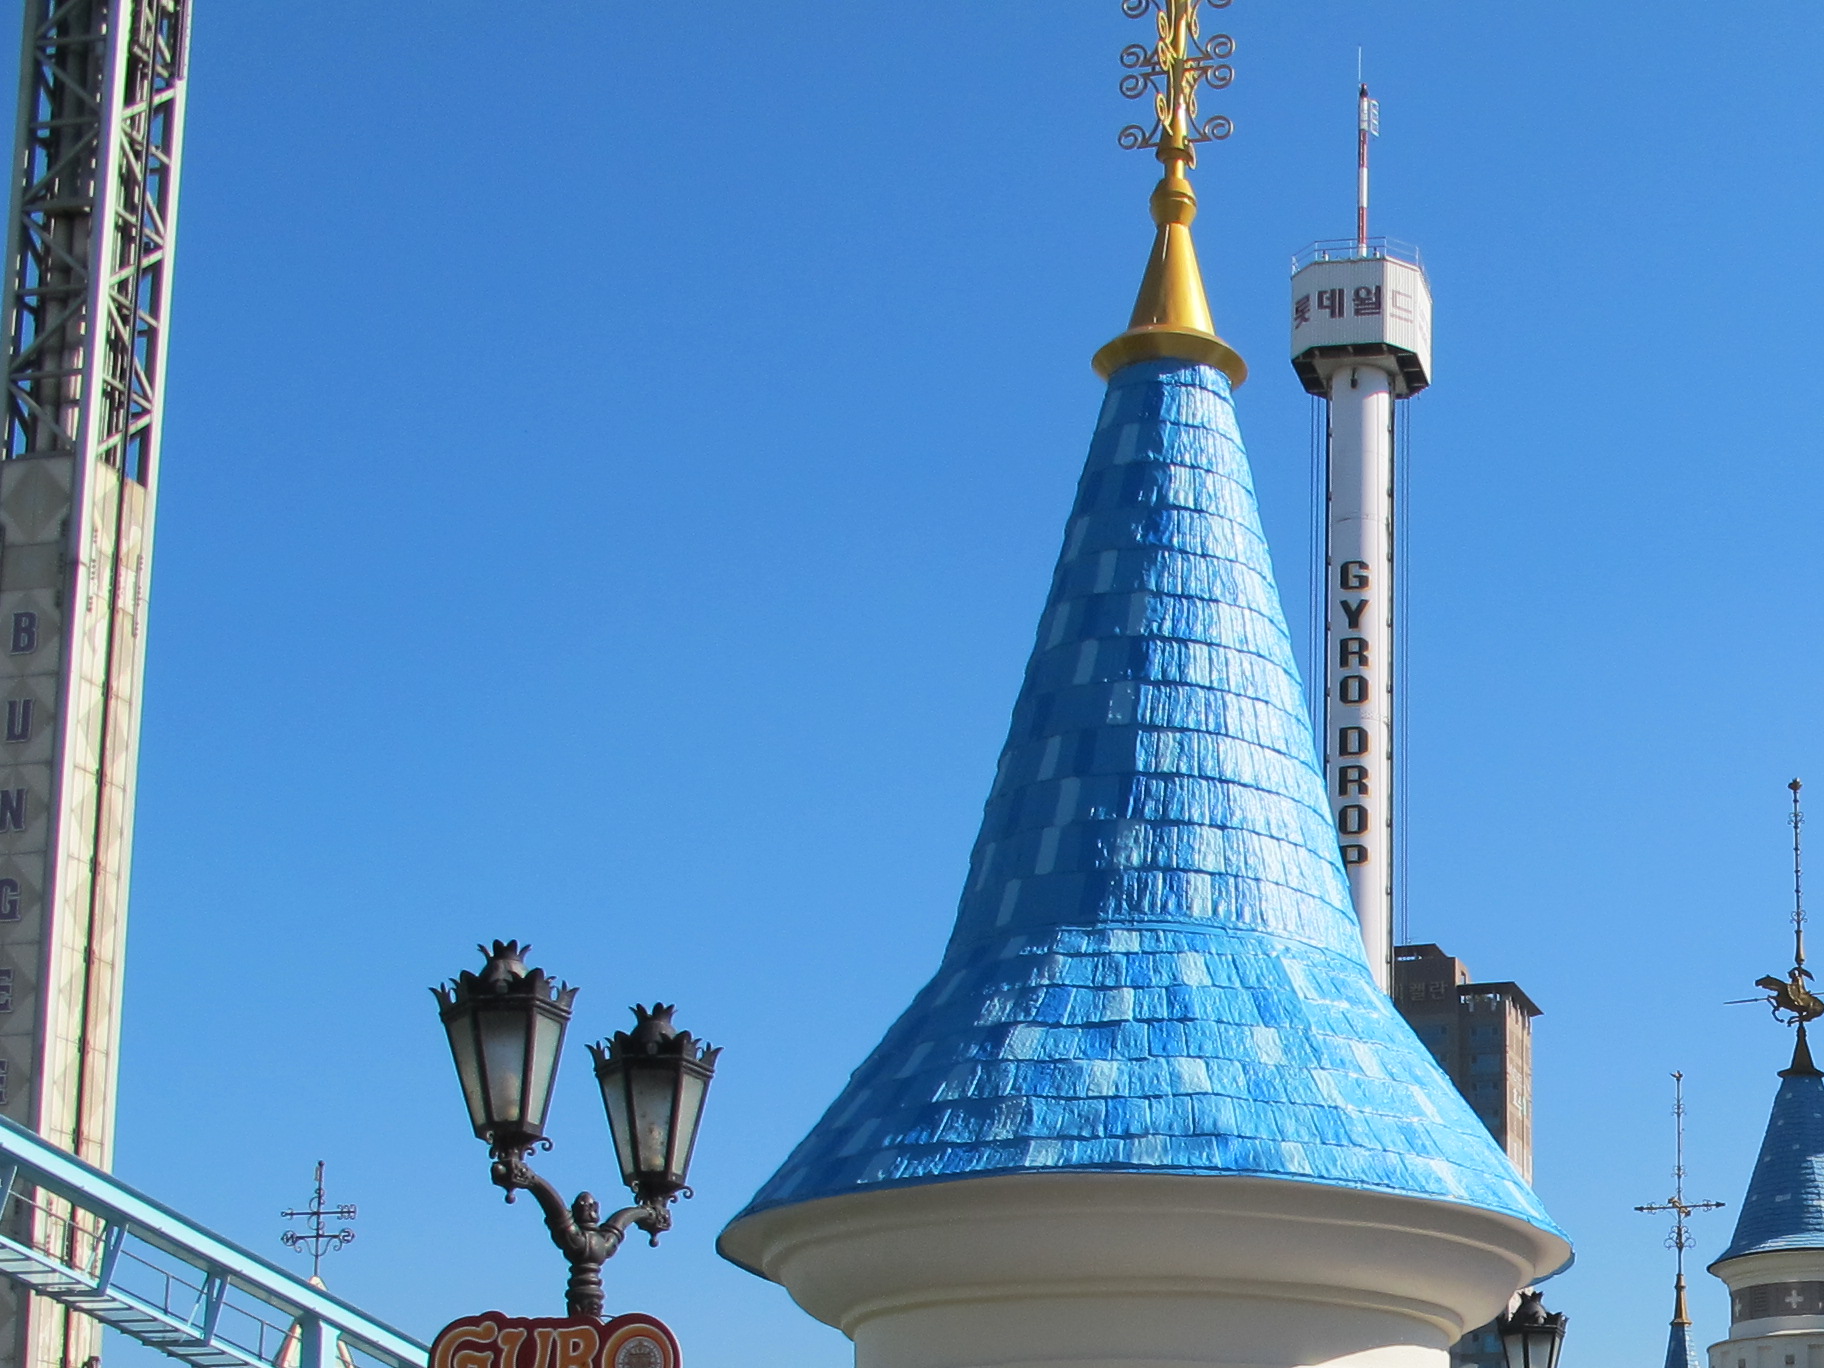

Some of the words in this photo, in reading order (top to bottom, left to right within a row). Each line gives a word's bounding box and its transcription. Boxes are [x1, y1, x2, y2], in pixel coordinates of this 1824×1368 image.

[1294, 285, 1415, 330] 롯데월드
[1340, 560, 1370, 705] GYRO
[1337, 725, 1370, 868] DROP
